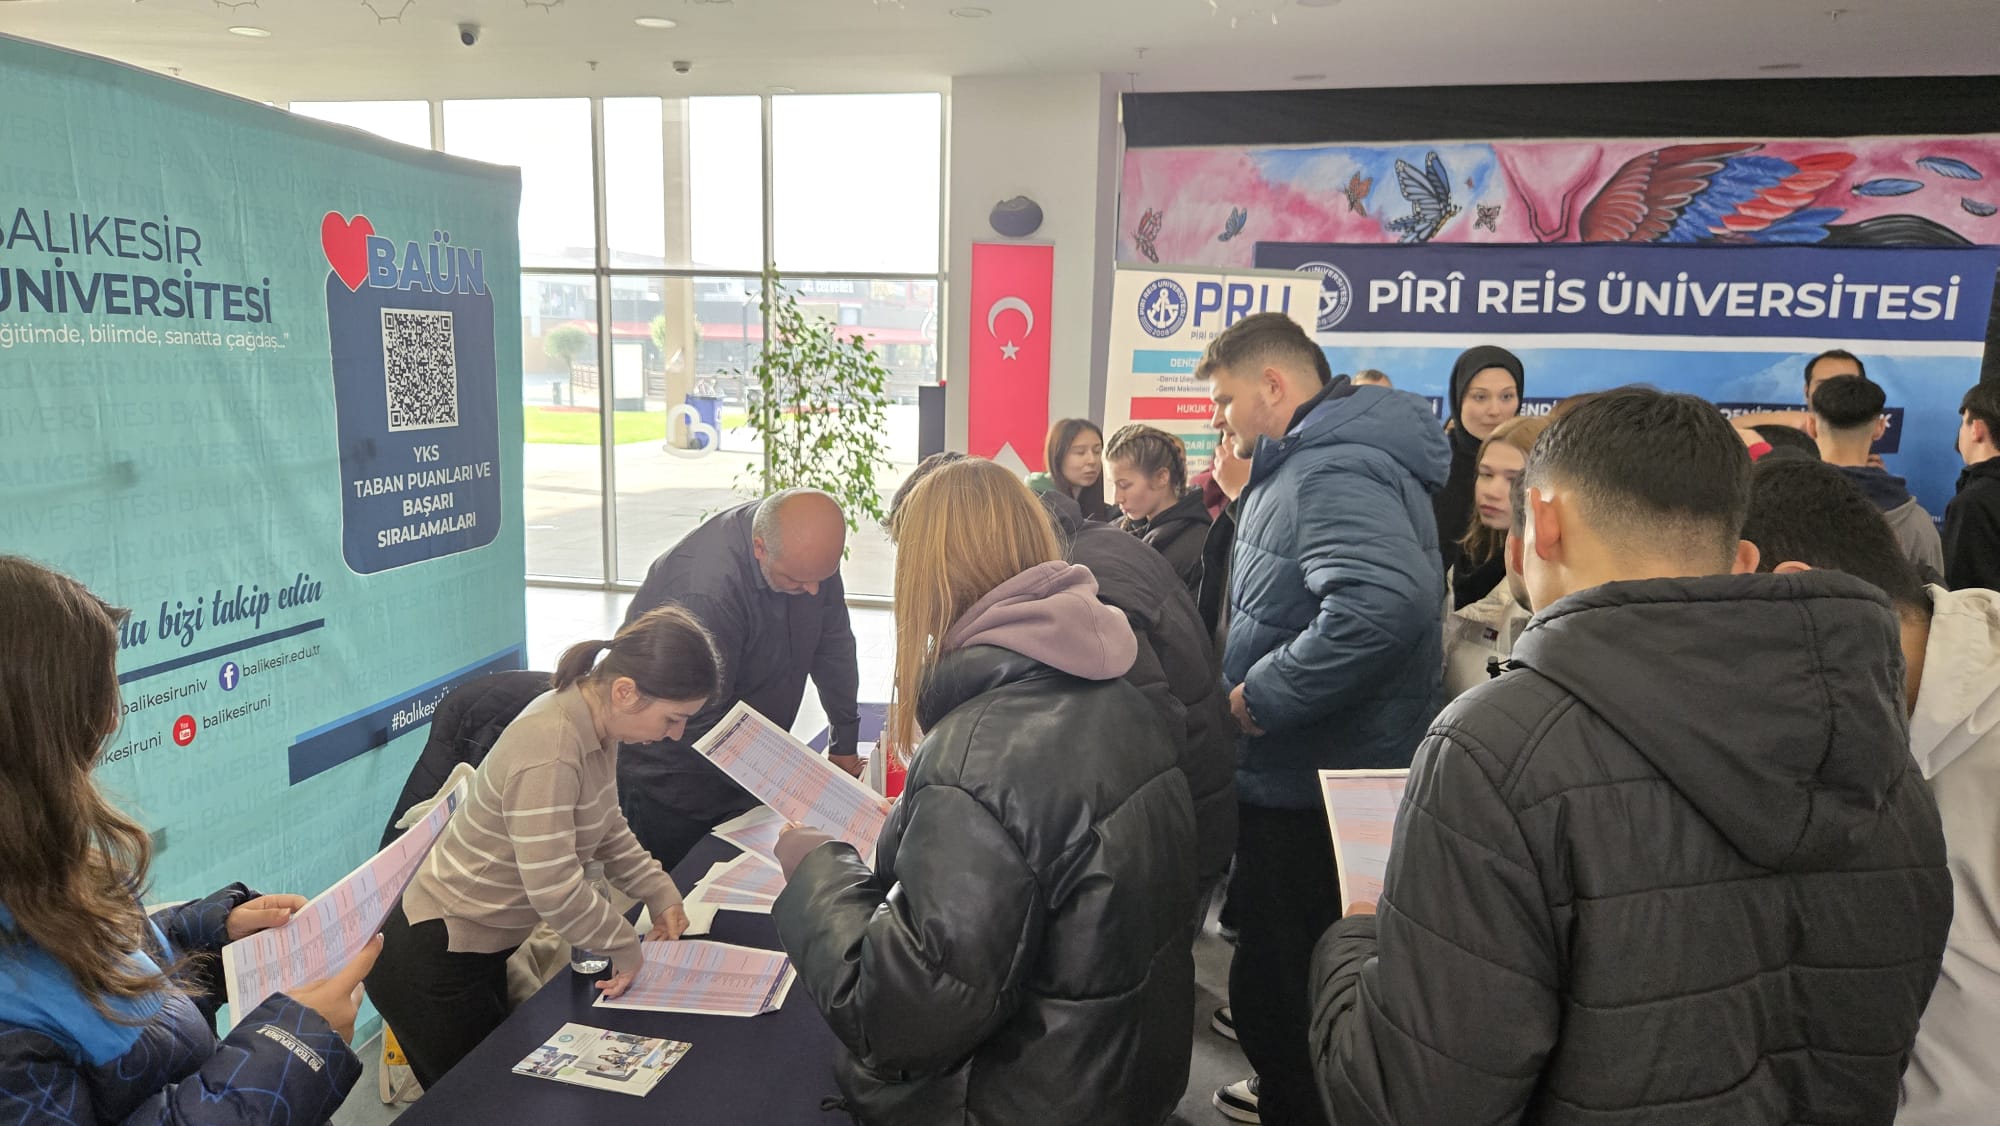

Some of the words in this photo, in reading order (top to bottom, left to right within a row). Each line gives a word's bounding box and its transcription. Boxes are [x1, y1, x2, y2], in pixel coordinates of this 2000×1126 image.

[0, 207, 202, 266] ALIKESİR
[366, 230, 486, 295] BAÜN
[1368, 270, 1465, 313] PÎRÎ
[1477, 269, 1586, 313] REİS
[1598, 271, 1961, 321] ÜNİVERSİTESİ
[90, 324, 162, 347] bilimde,
[165, 329, 222, 346] sanatta
[413, 445, 440, 463] YKS
[354, 475, 403, 498] TABAN
[408, 465, 473, 490] PUANLARI
[475, 462, 491, 478] VE
[403, 492, 454, 517] BAŞARI
[378, 512, 476, 548] SIRALAMALARI
[159, 597, 205, 647] bizi
[212, 585, 271, 629] takip
[278, 573, 323, 609] edin
[242, 644, 321, 677] balikesir.edu.tr
[203, 694, 271, 729] balikesiruni
[264, 1029, 296, 1051] EXPLORER
[293, 1046, 311, 1063] TECH
[308, 1058, 321, 1072] PRO
